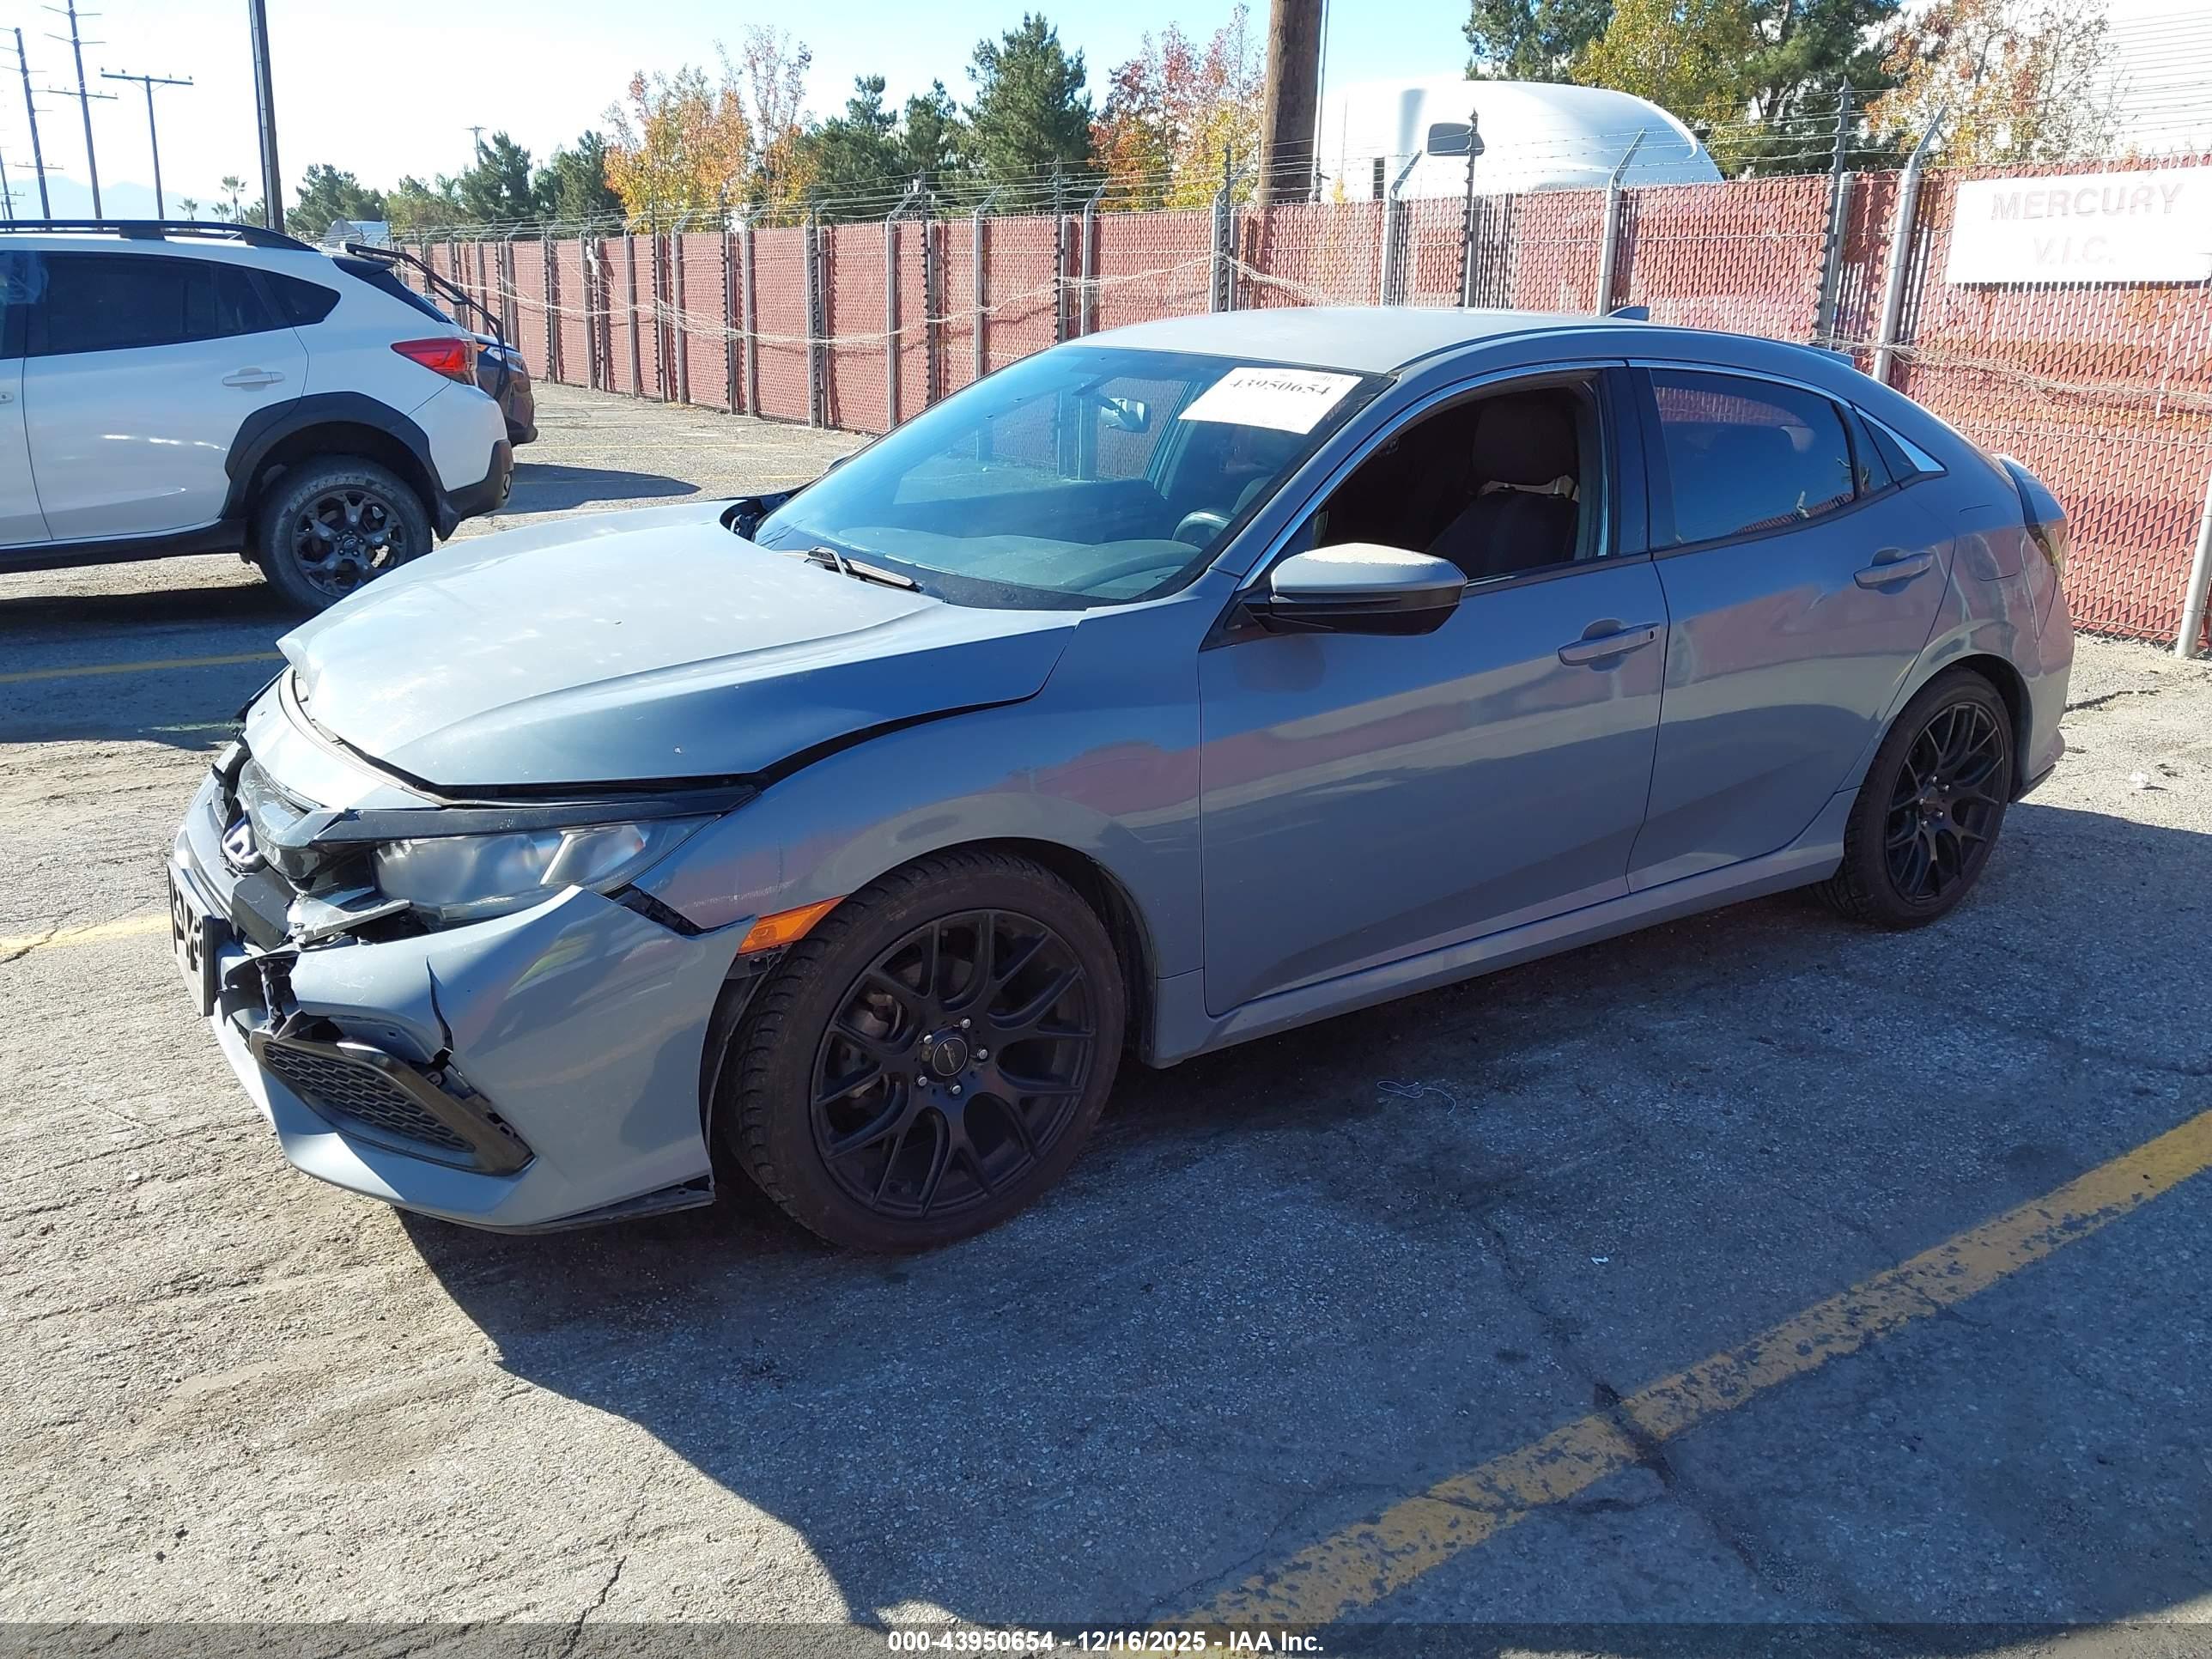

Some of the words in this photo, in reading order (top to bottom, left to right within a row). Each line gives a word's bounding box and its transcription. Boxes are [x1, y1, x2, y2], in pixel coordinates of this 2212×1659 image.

[1990, 183, 2185, 221] MERCURY
[2033, 234, 2117, 266] V.I.C.
[1230, 379, 1332, 395] 43950654
